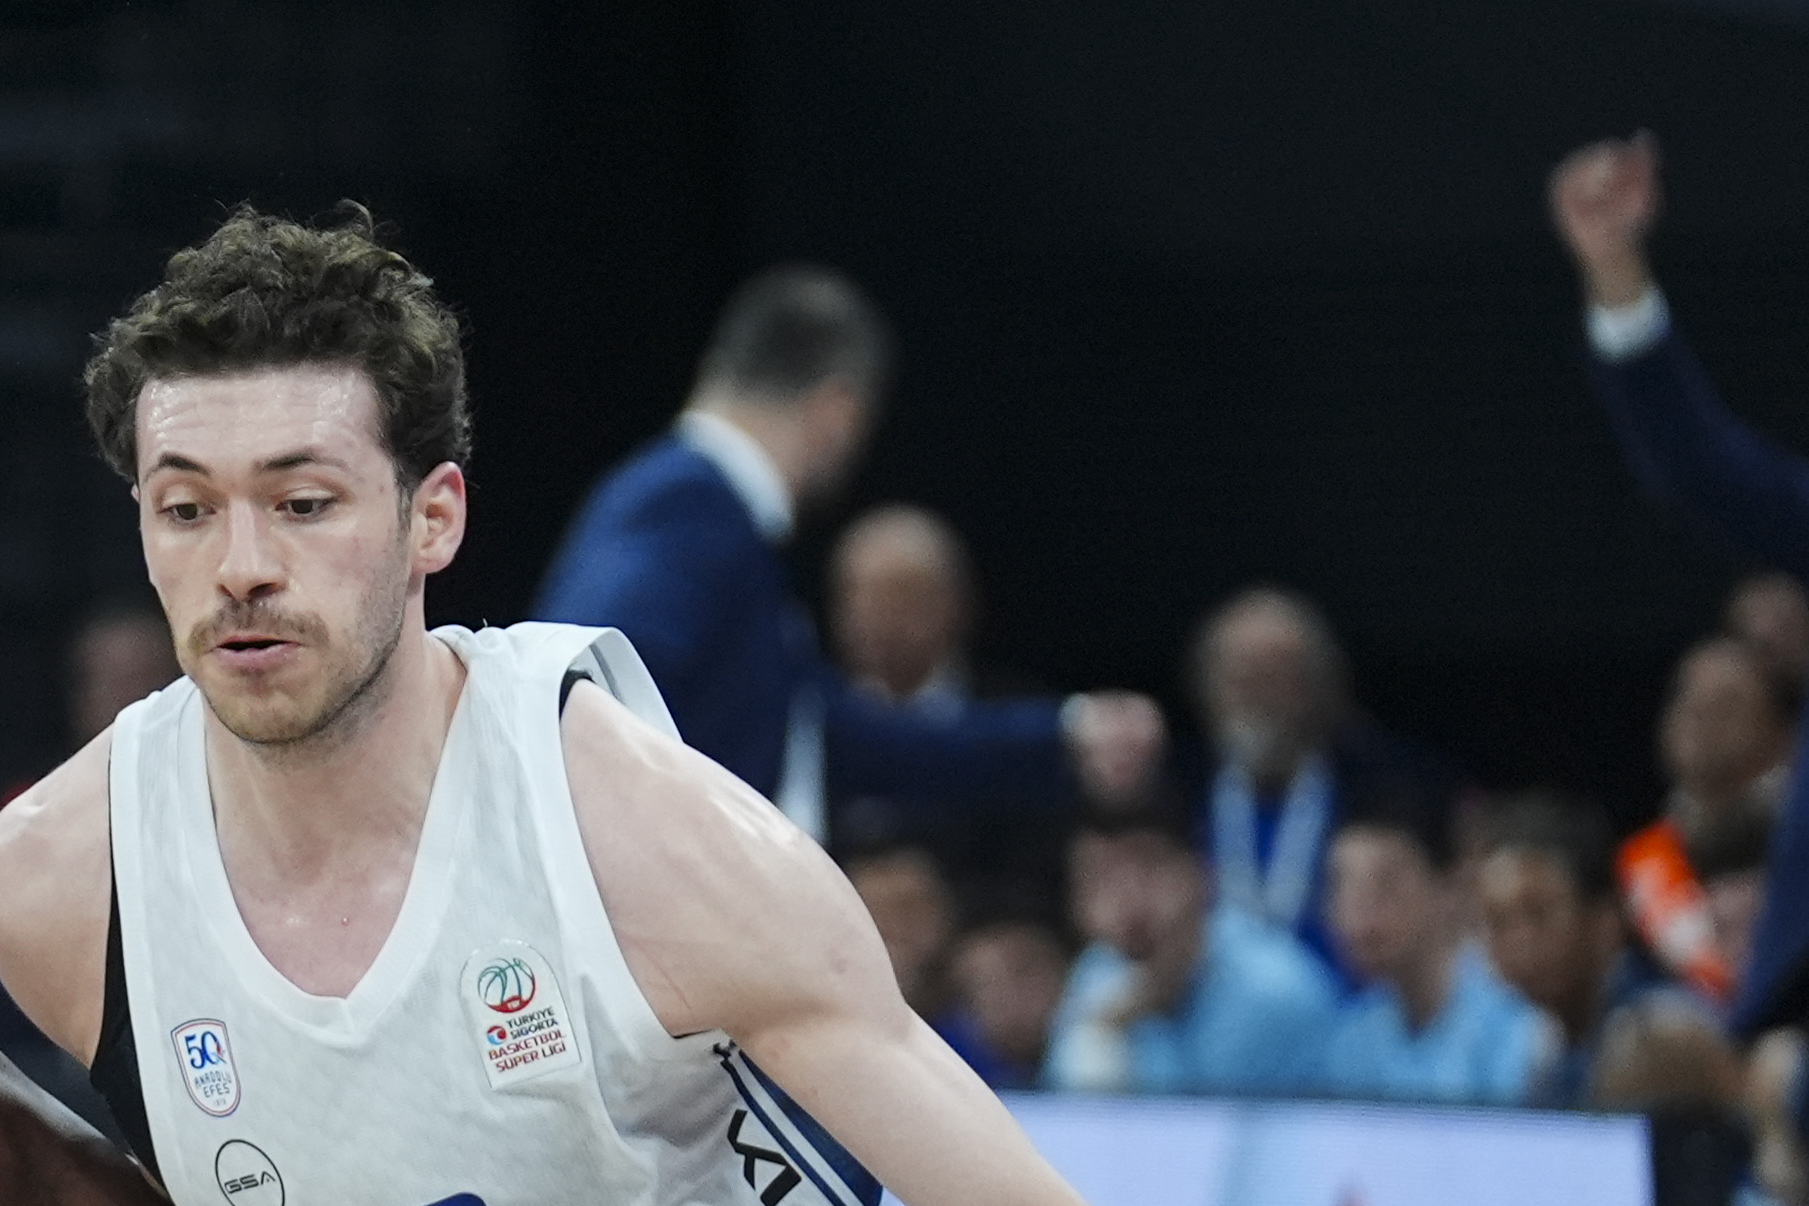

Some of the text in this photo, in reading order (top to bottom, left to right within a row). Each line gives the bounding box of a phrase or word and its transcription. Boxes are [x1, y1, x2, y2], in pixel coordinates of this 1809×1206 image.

[488, 1029, 567, 1060] BASKETBOL
[203, 1083, 231, 1098] EFES
[224, 1171, 276, 1194] GSA
